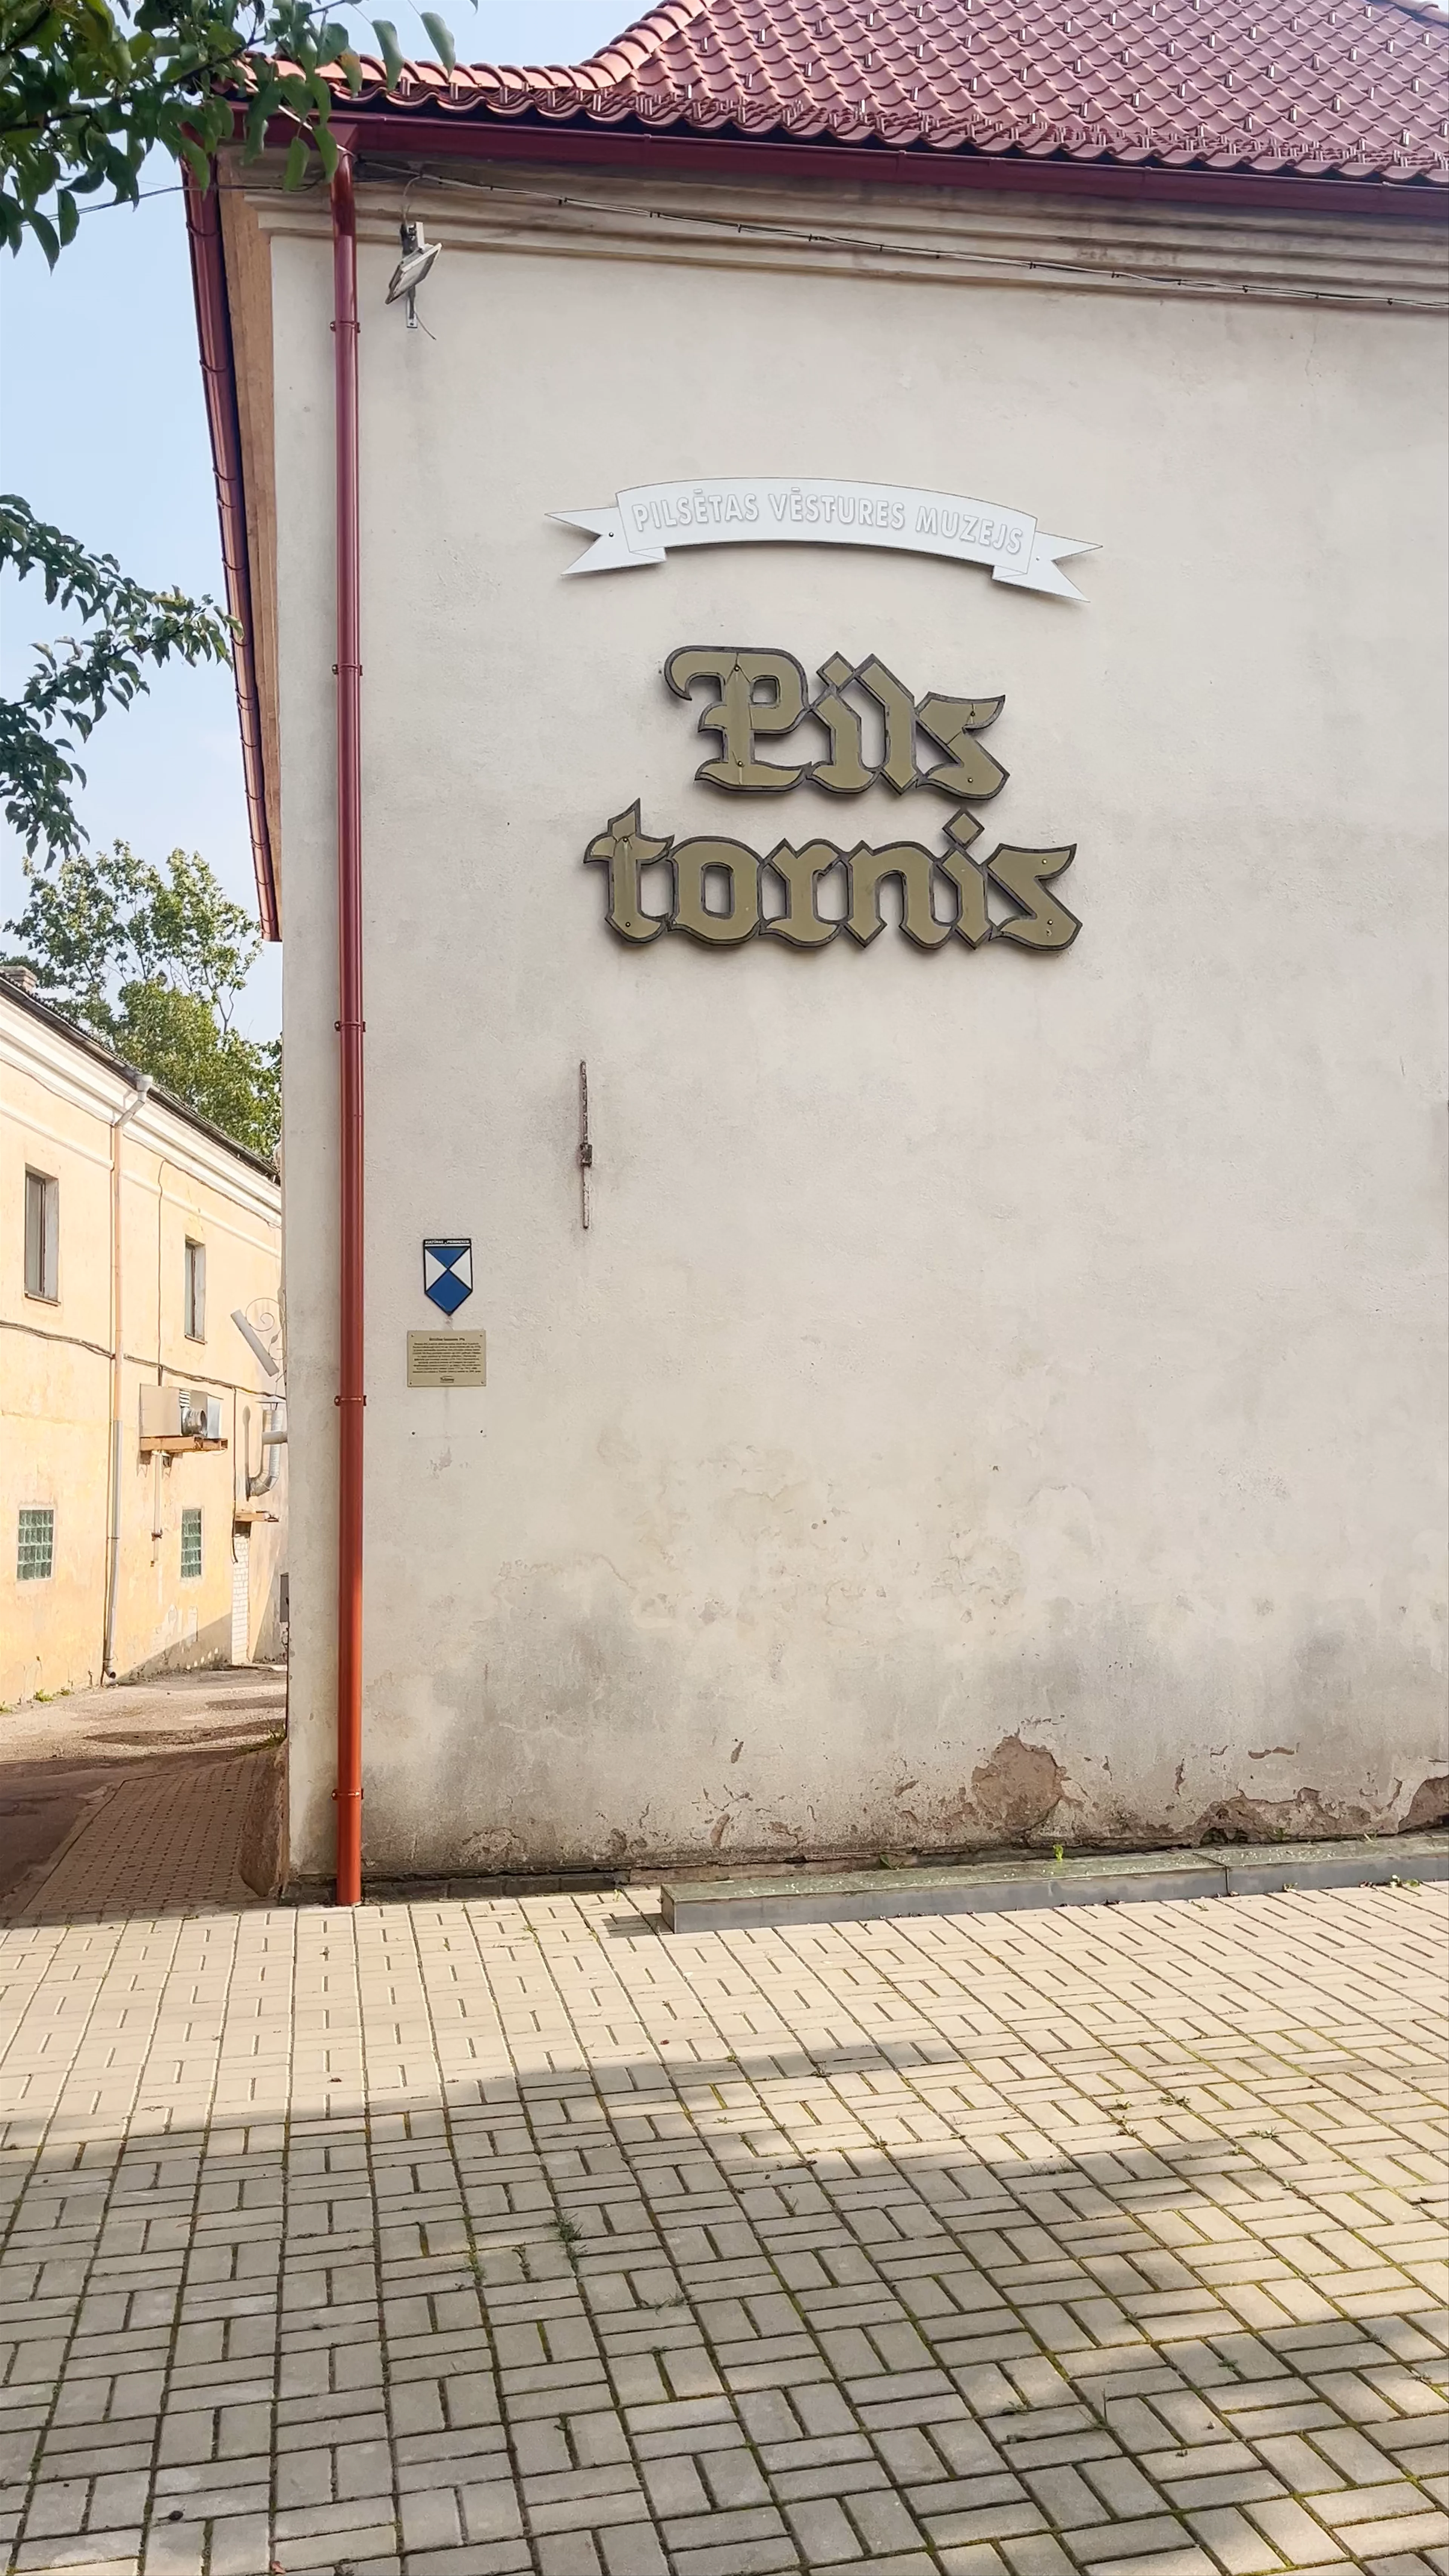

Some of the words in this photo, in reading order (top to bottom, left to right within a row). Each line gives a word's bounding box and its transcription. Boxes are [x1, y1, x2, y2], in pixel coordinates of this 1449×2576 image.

[631, 488, 759, 532] PILSĒTAS
[768, 486, 905, 529] VĒSTURES
[915, 506, 1023, 554] MUZEJS
[664, 645, 1010, 802] Pils
[583, 798, 1083, 952] tornis
